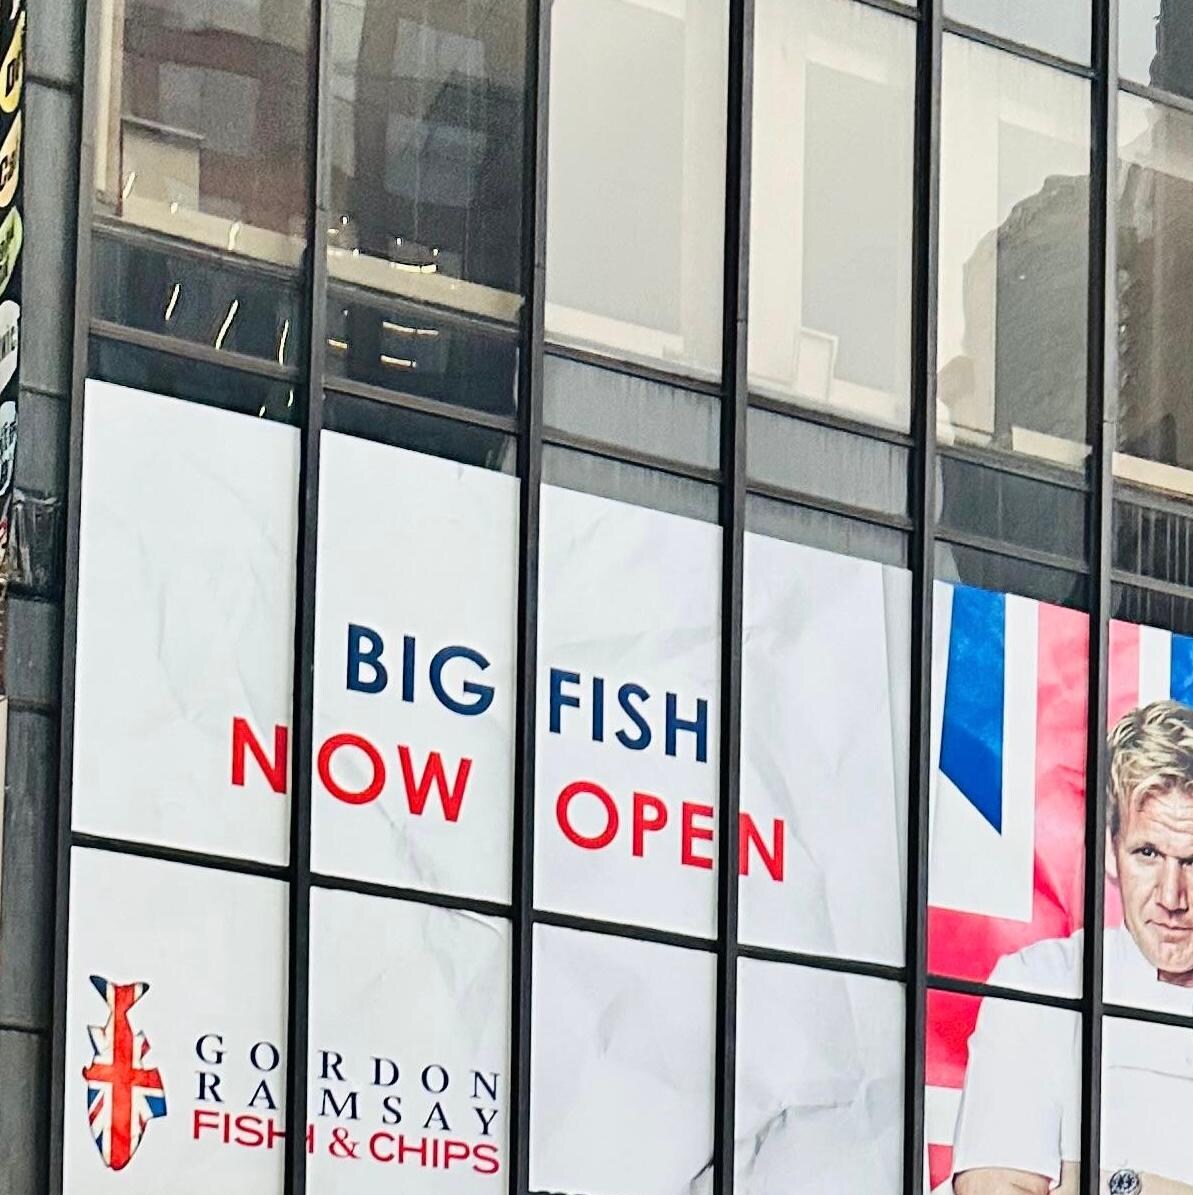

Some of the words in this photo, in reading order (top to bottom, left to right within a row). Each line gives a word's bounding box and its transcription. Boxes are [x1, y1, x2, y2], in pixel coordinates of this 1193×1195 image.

[347, 624, 494, 716] BIG
[549, 668, 708, 763] FISH
[230, 716, 473, 824] NOW
[554, 779, 786, 884] OPEN
[195, 1034, 501, 1101] GORDON
[194, 1071, 500, 1137] RAMSAY
[192, 1108, 316, 1153] FISH
[327, 1128, 361, 1160] &
[368, 1131, 501, 1175] CHIPS
